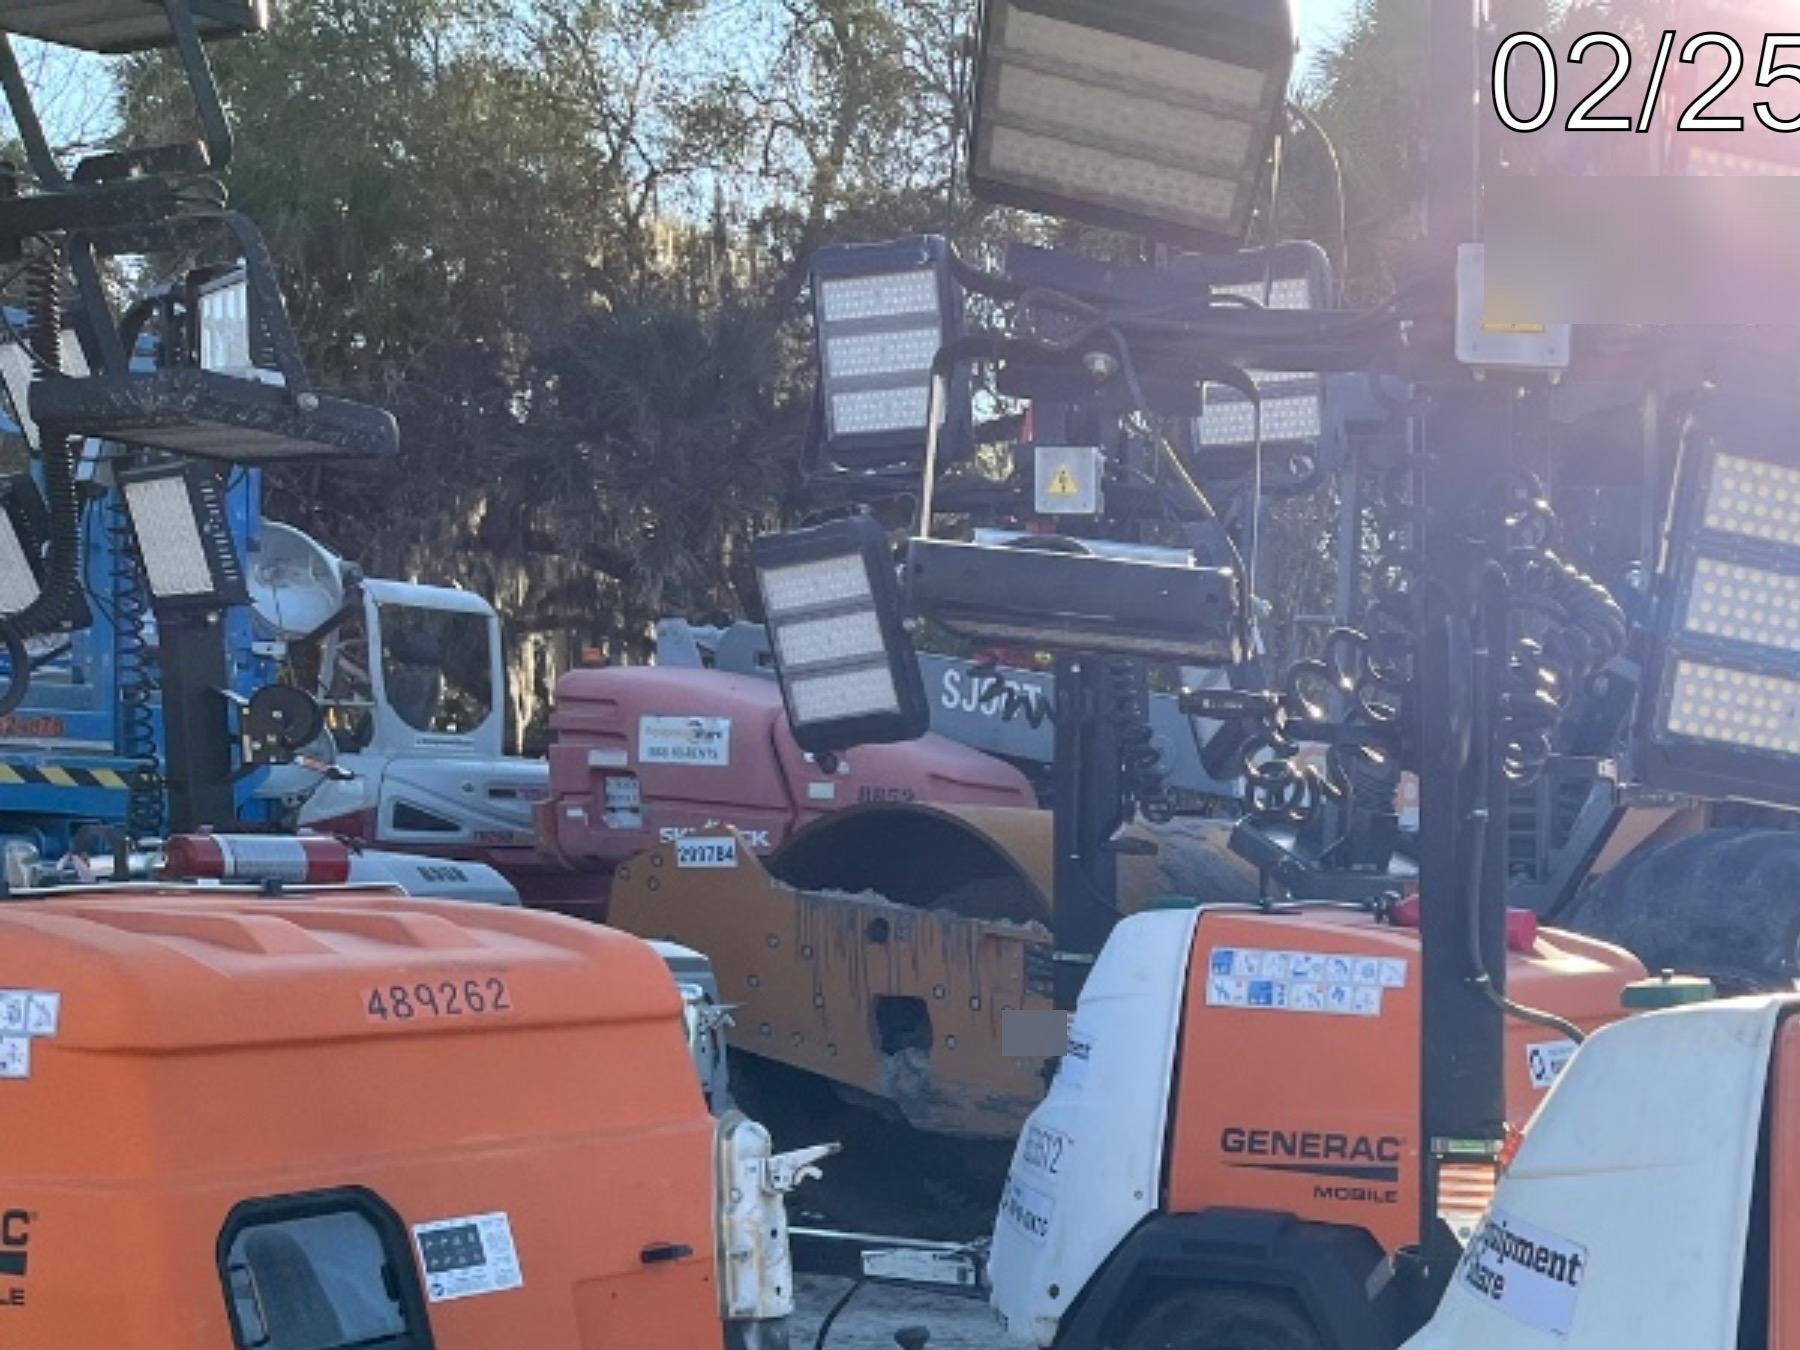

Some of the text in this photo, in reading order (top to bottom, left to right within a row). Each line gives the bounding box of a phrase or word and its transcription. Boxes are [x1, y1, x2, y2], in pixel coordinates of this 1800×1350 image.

[368, 977, 510, 1020] 489262
[1220, 1127, 1401, 1163] GENERAC
[1313, 1185, 1398, 1204] MOBILE
